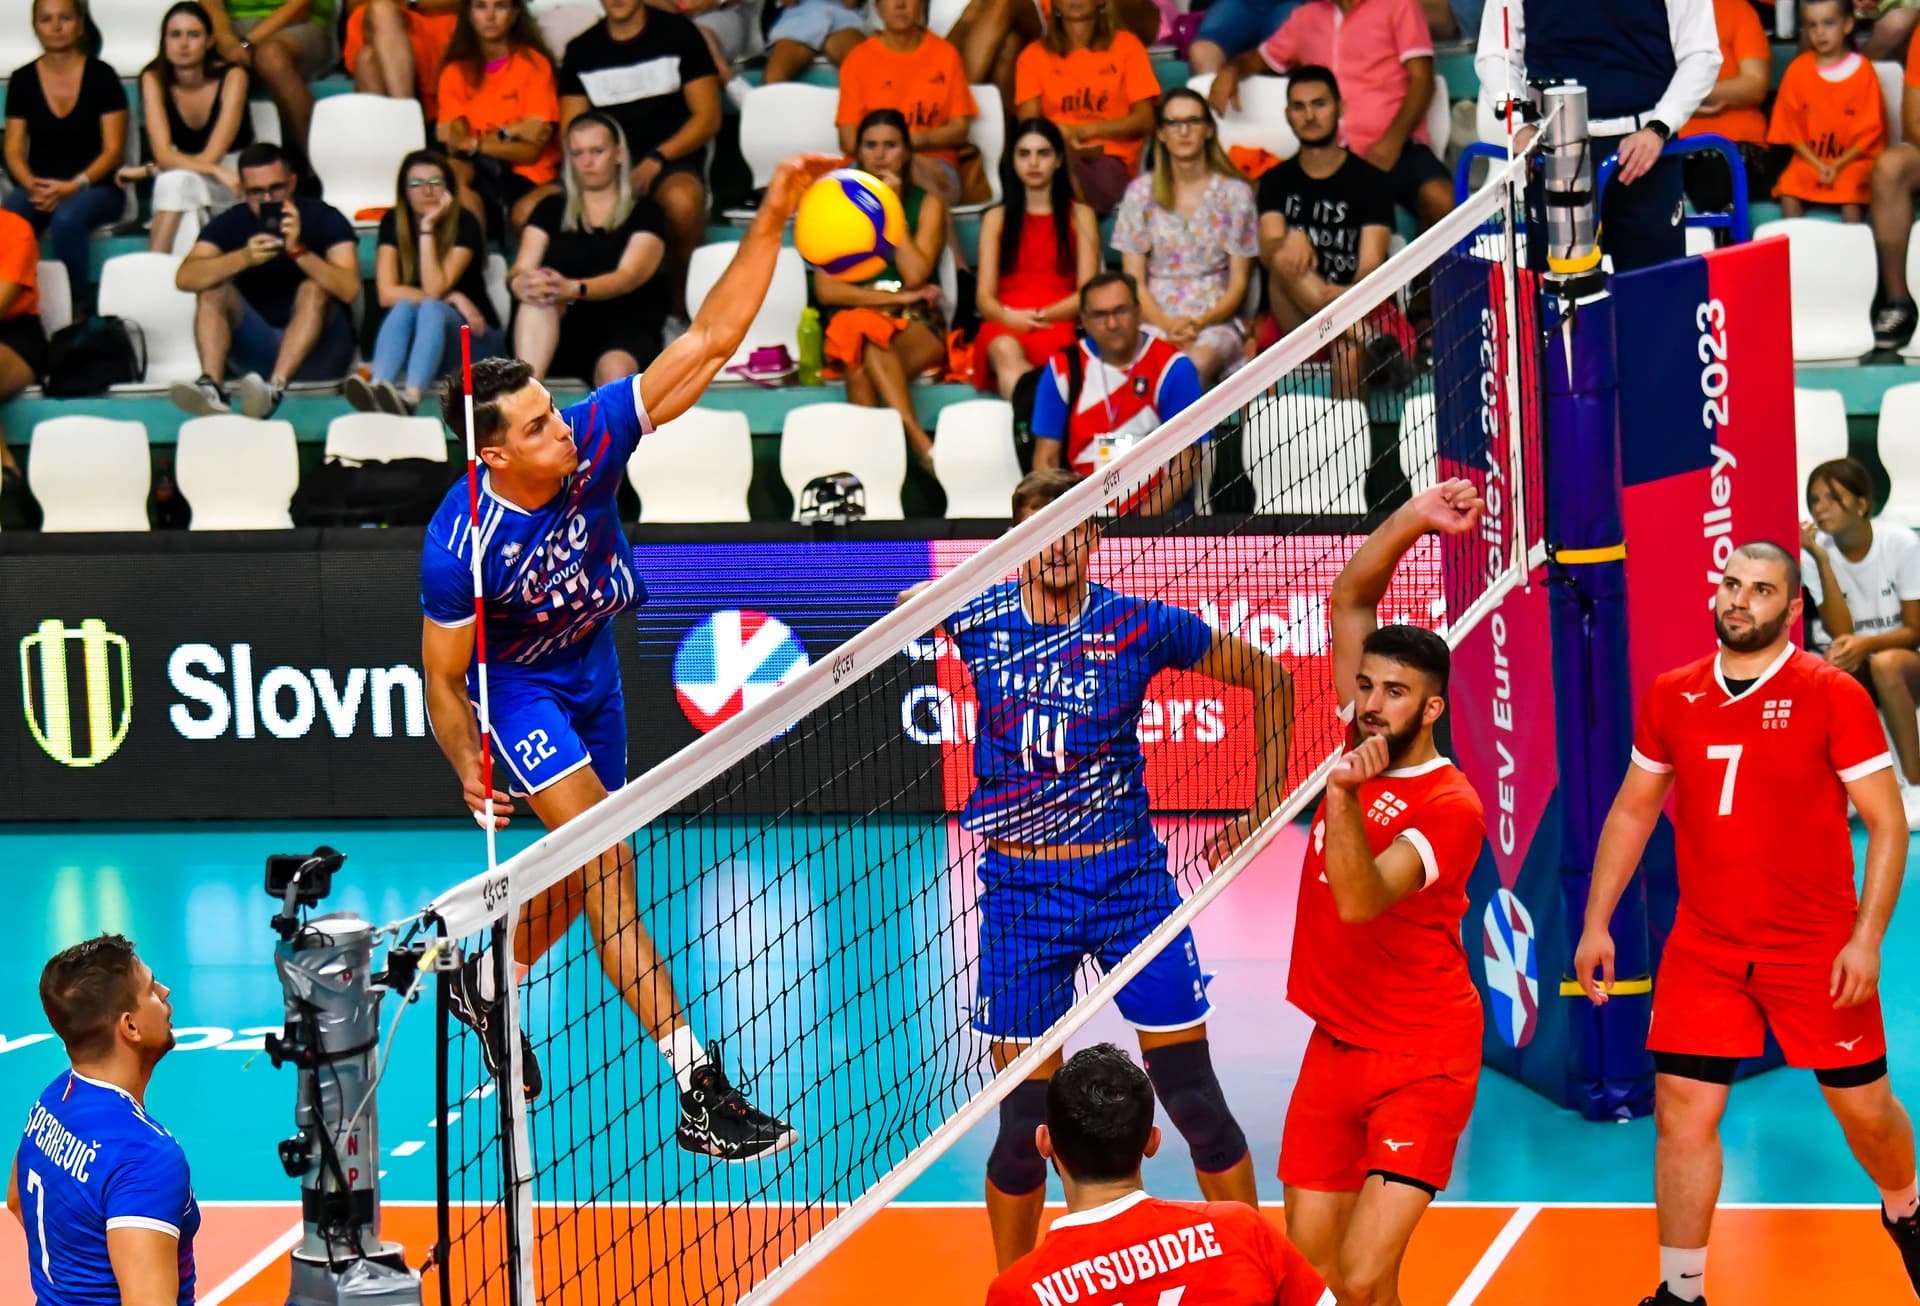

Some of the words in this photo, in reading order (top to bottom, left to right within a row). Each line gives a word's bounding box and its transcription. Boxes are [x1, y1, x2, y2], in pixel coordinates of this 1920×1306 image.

[1480, 308, 1499, 438] 2023
[1696, 298, 1729, 429] 2023
[514, 728, 557, 772] 22
[1020, 708, 1069, 774] 14
[1762, 718, 1788, 730] GEO
[1367, 808, 1391, 827] GEO
[1497, 740, 1516, 856] CEV
[1706, 744, 1743, 816] 7
[27, 1167, 54, 1285] 7
[1031, 1222, 1223, 1306] NUTSUBIDZE
